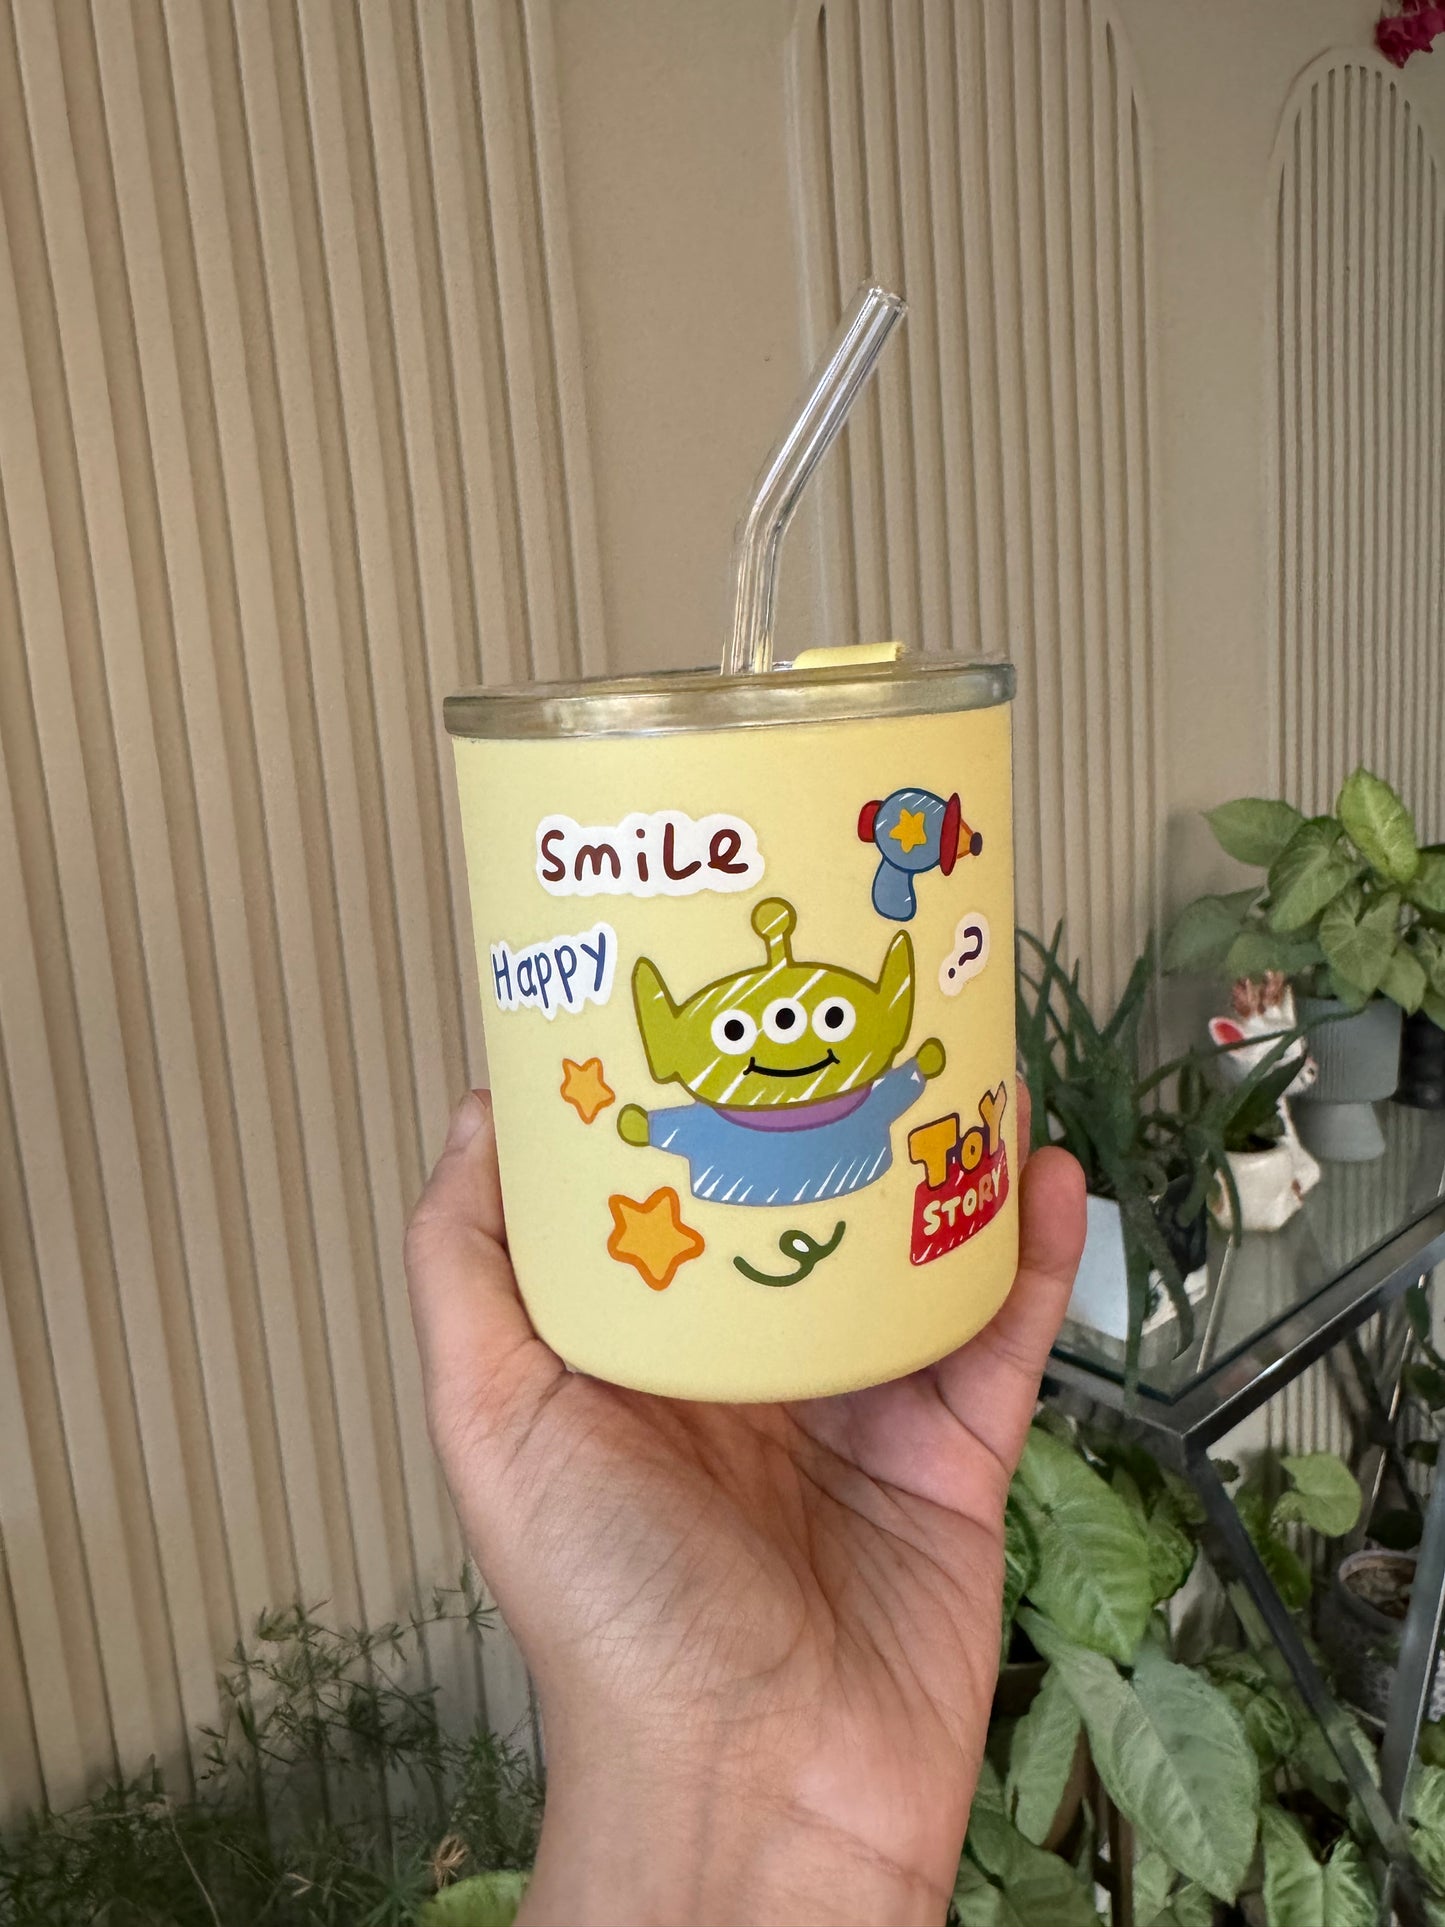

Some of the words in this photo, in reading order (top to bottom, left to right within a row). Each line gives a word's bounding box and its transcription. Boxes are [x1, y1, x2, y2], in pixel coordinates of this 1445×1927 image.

[493, 932, 606, 1009] Happy
[947, 926, 983, 980] ?
[923, 1163, 1001, 1236] STORY
